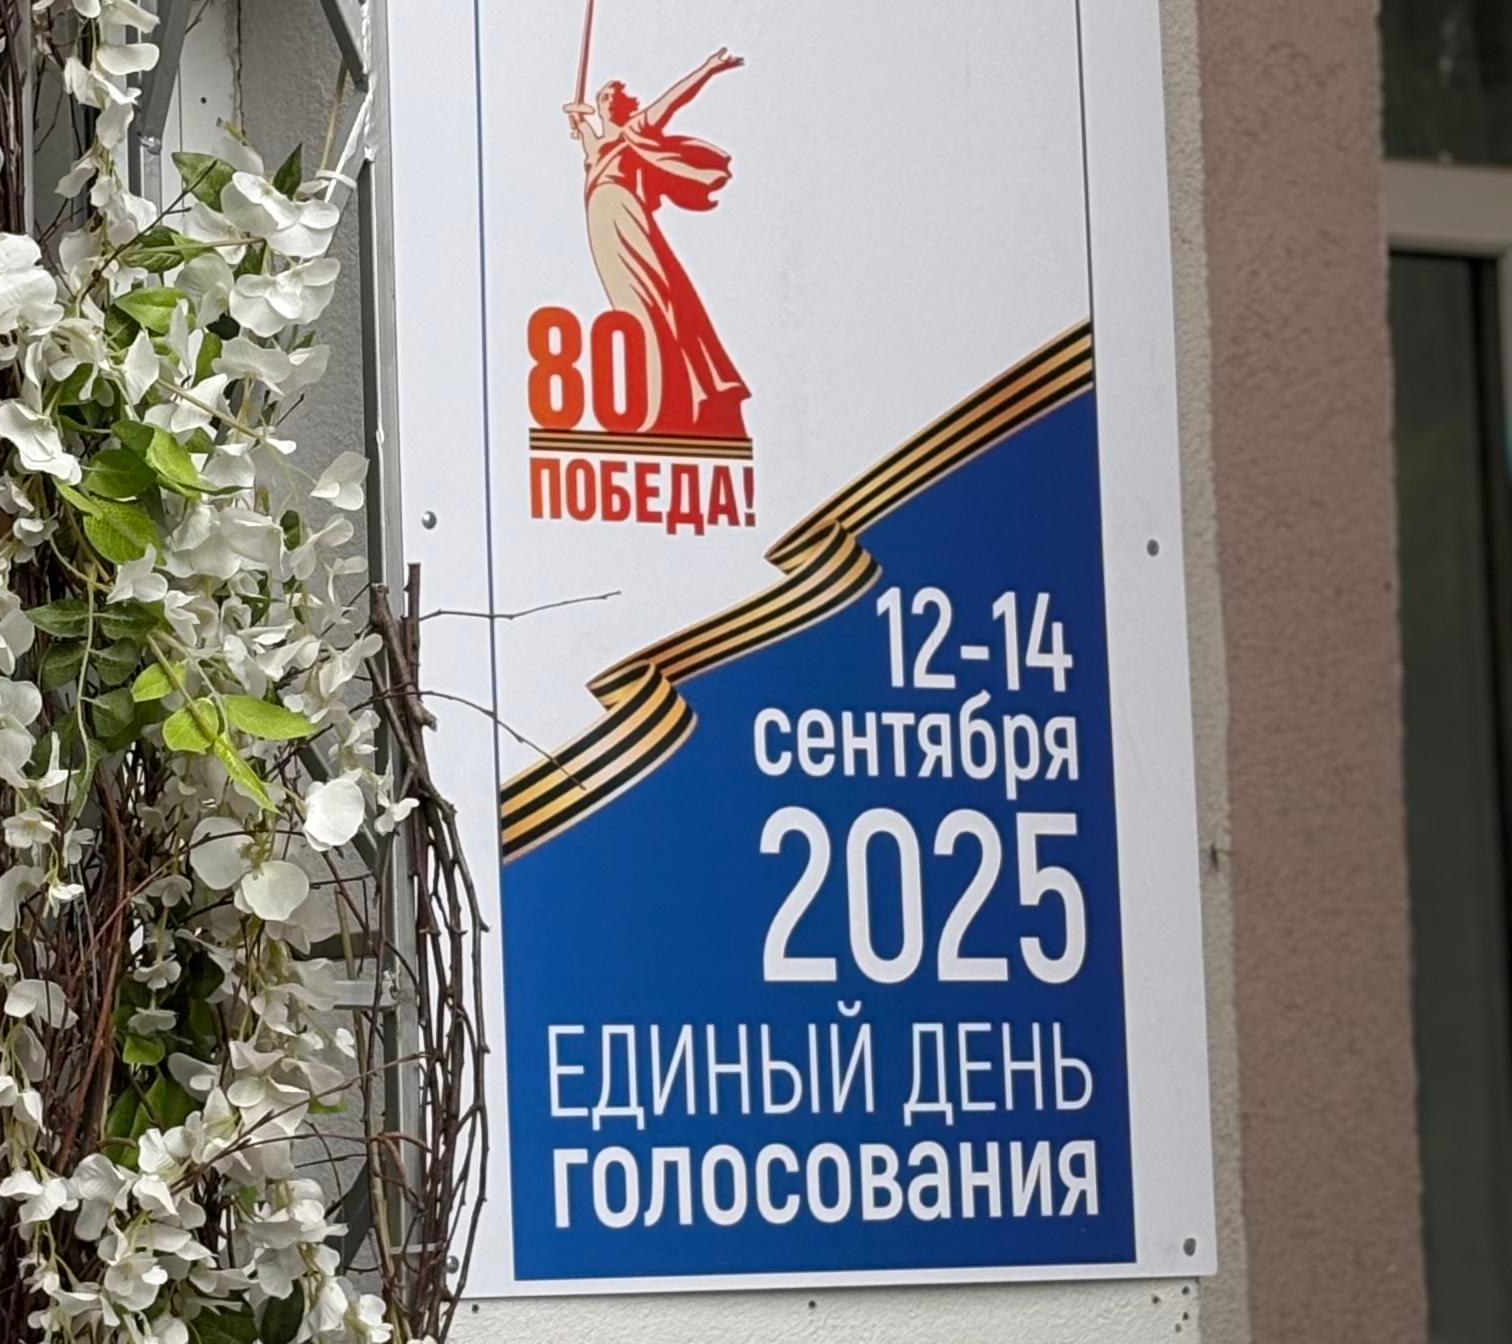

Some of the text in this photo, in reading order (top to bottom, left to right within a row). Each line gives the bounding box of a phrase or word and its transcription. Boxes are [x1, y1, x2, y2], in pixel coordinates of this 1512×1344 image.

[526, 306, 647, 433] 80
[528, 456, 757, 535] ПОБЕДА!
[875, 586, 1073, 692] 12-14
[753, 690, 1079, 800] сентября
[759, 805, 1087, 985] 2025
[547, 1000, 1094, 1132] ЕДИНЫЙ ДЕНЬ
